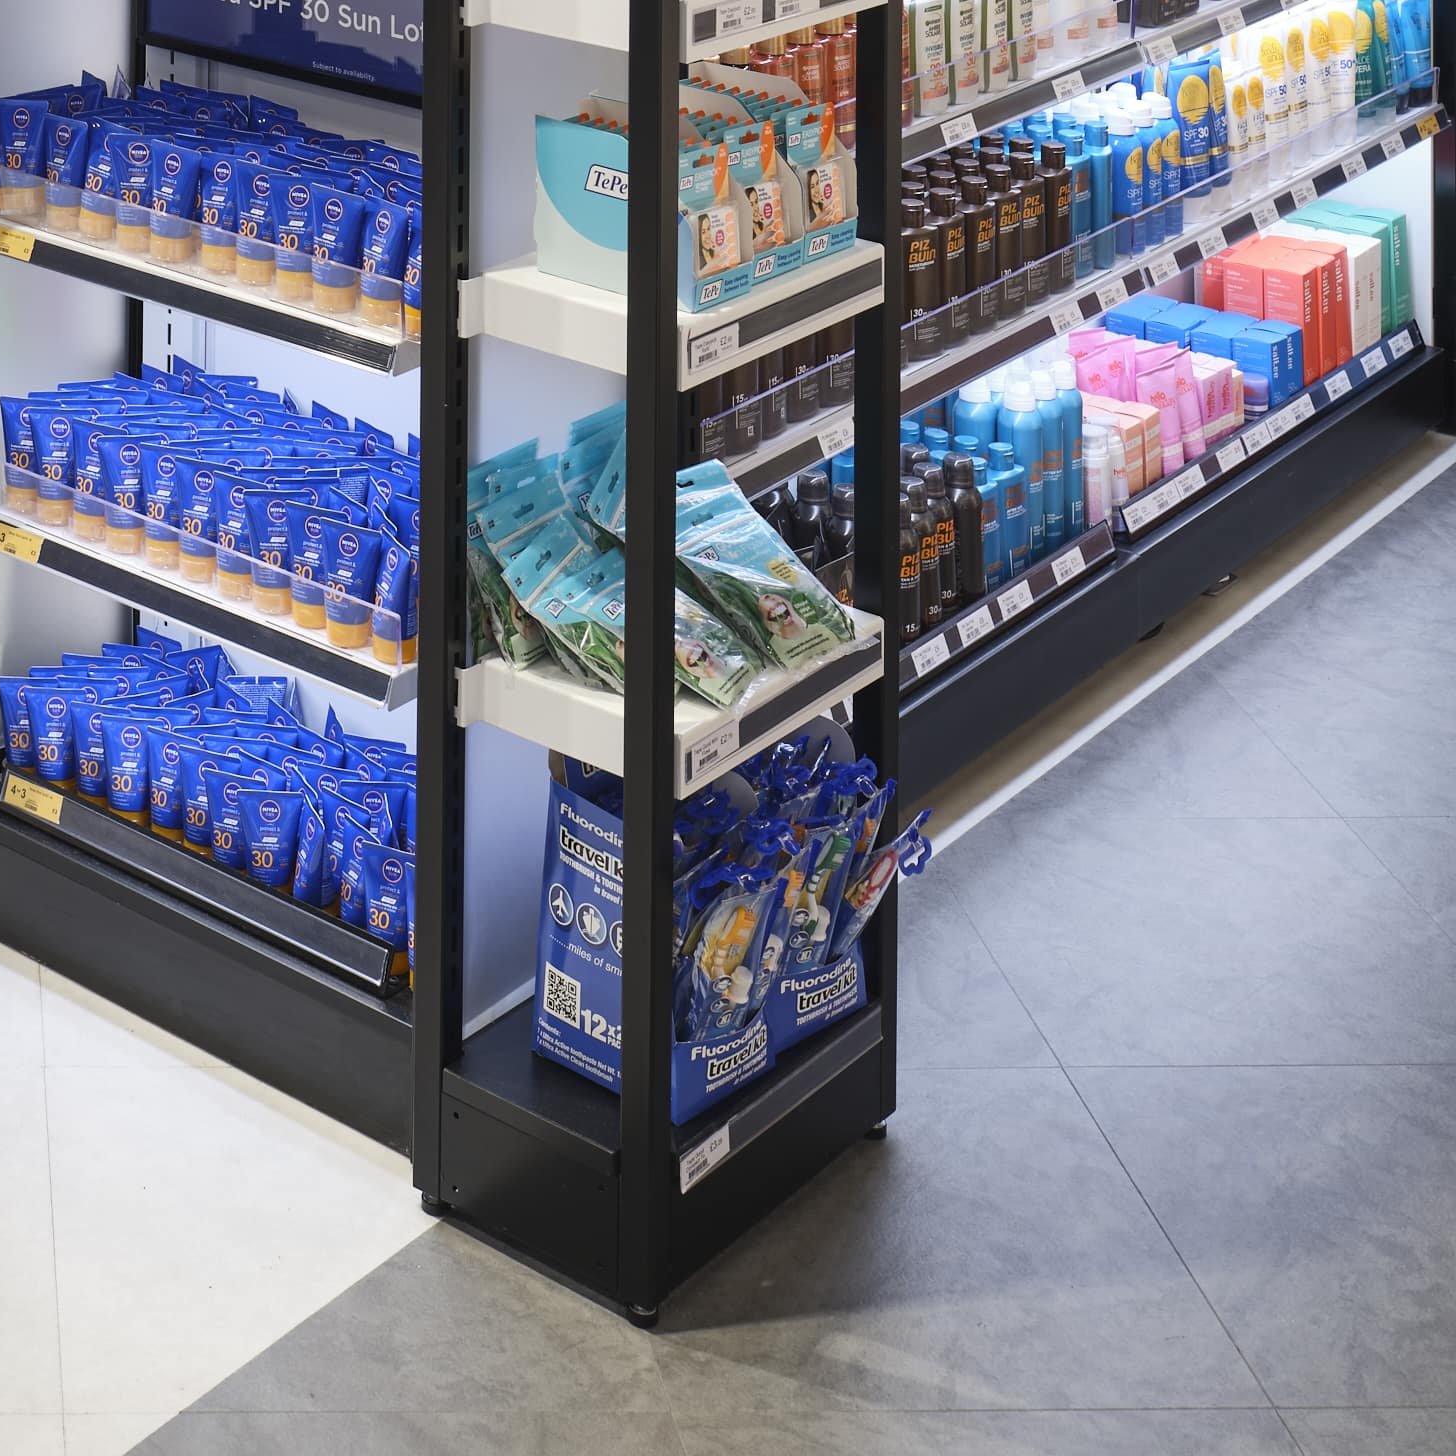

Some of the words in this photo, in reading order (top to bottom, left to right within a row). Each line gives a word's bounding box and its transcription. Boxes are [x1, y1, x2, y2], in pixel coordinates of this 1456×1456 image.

[338, 4, 381, 35] Sun
[311, 60, 334, 75] Subject
[1184, 128, 1198, 141] SPF
[1197, 126, 1209, 139] 30
[592, 169, 629, 194] TePe
[1001, 201, 1018, 215] PIZ
[1023, 194, 1041, 208] PIZ
[810, 235, 828, 253] TePe
[910, 239, 931, 253] PIZ
[908, 247, 936, 265] BUIN
[756, 257, 773, 275] TePe
[702, 282, 721, 300] TePe
[114, 492, 136, 510] 30
[259, 550, 282, 569] 30
[559, 802, 623, 849] Fluorodi
[560, 825, 610, 875] travel
[780, 957, 852, 995] Fluorodine
[797, 980, 842, 1013] travel
[841, 962, 858, 989] kit
[691, 1019, 763, 1062] Fluorodine
[707, 1046, 751, 1080] travel
[751, 1023, 768, 1052] kit
